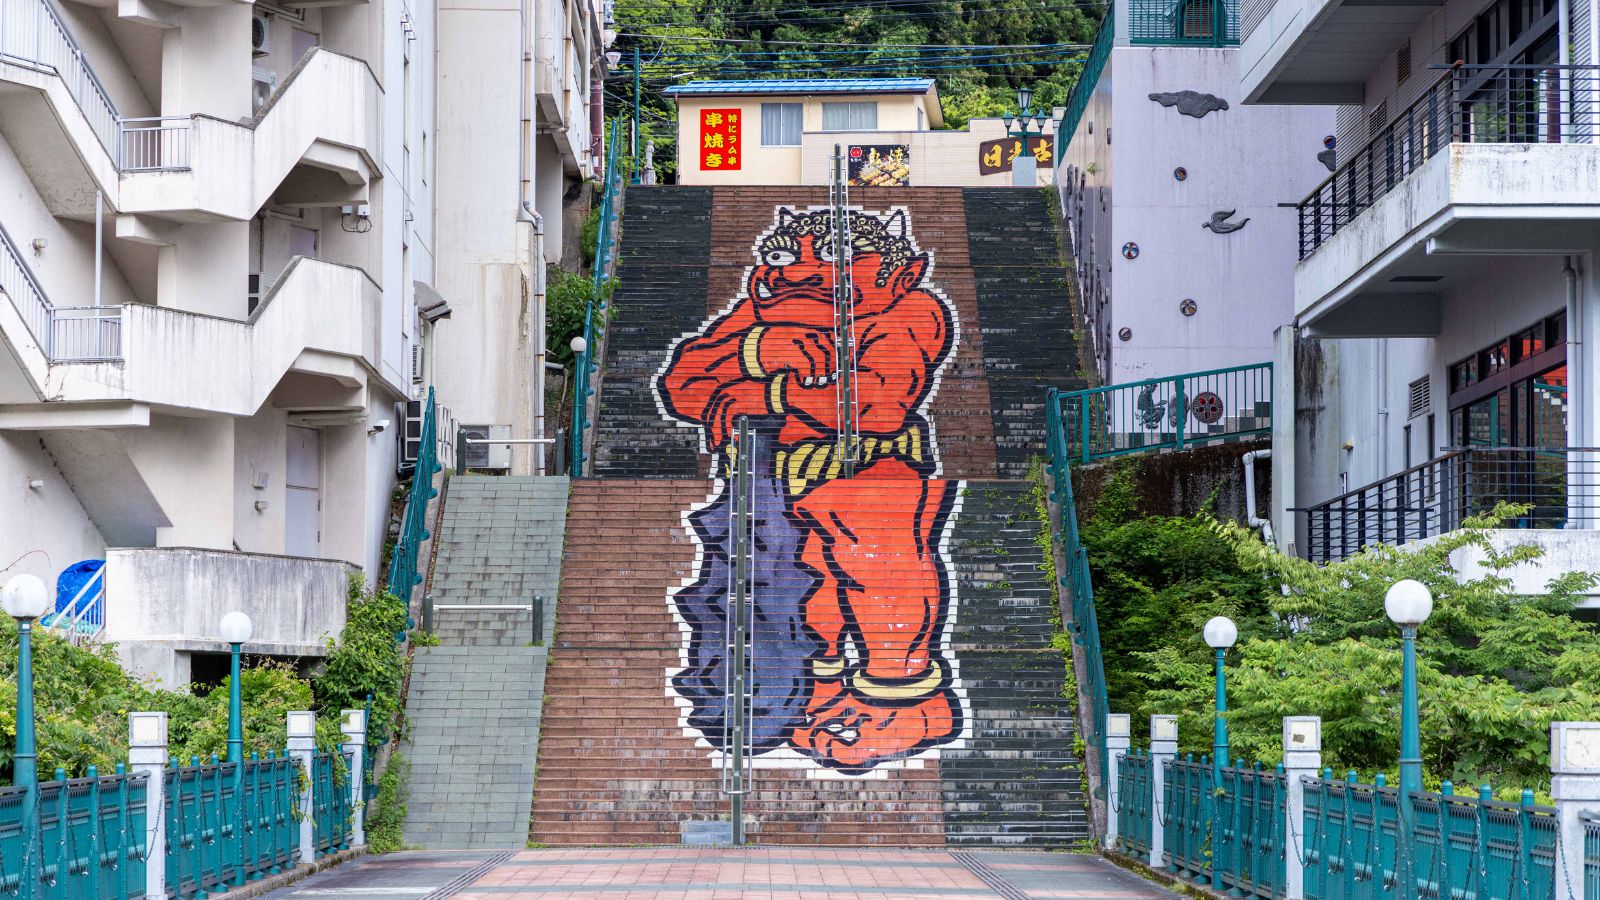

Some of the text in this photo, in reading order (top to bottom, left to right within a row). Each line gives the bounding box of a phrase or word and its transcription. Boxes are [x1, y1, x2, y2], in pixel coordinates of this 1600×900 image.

[704, 112, 723, 167] 串焼き
[728, 114, 737, 165] 特にラム串
